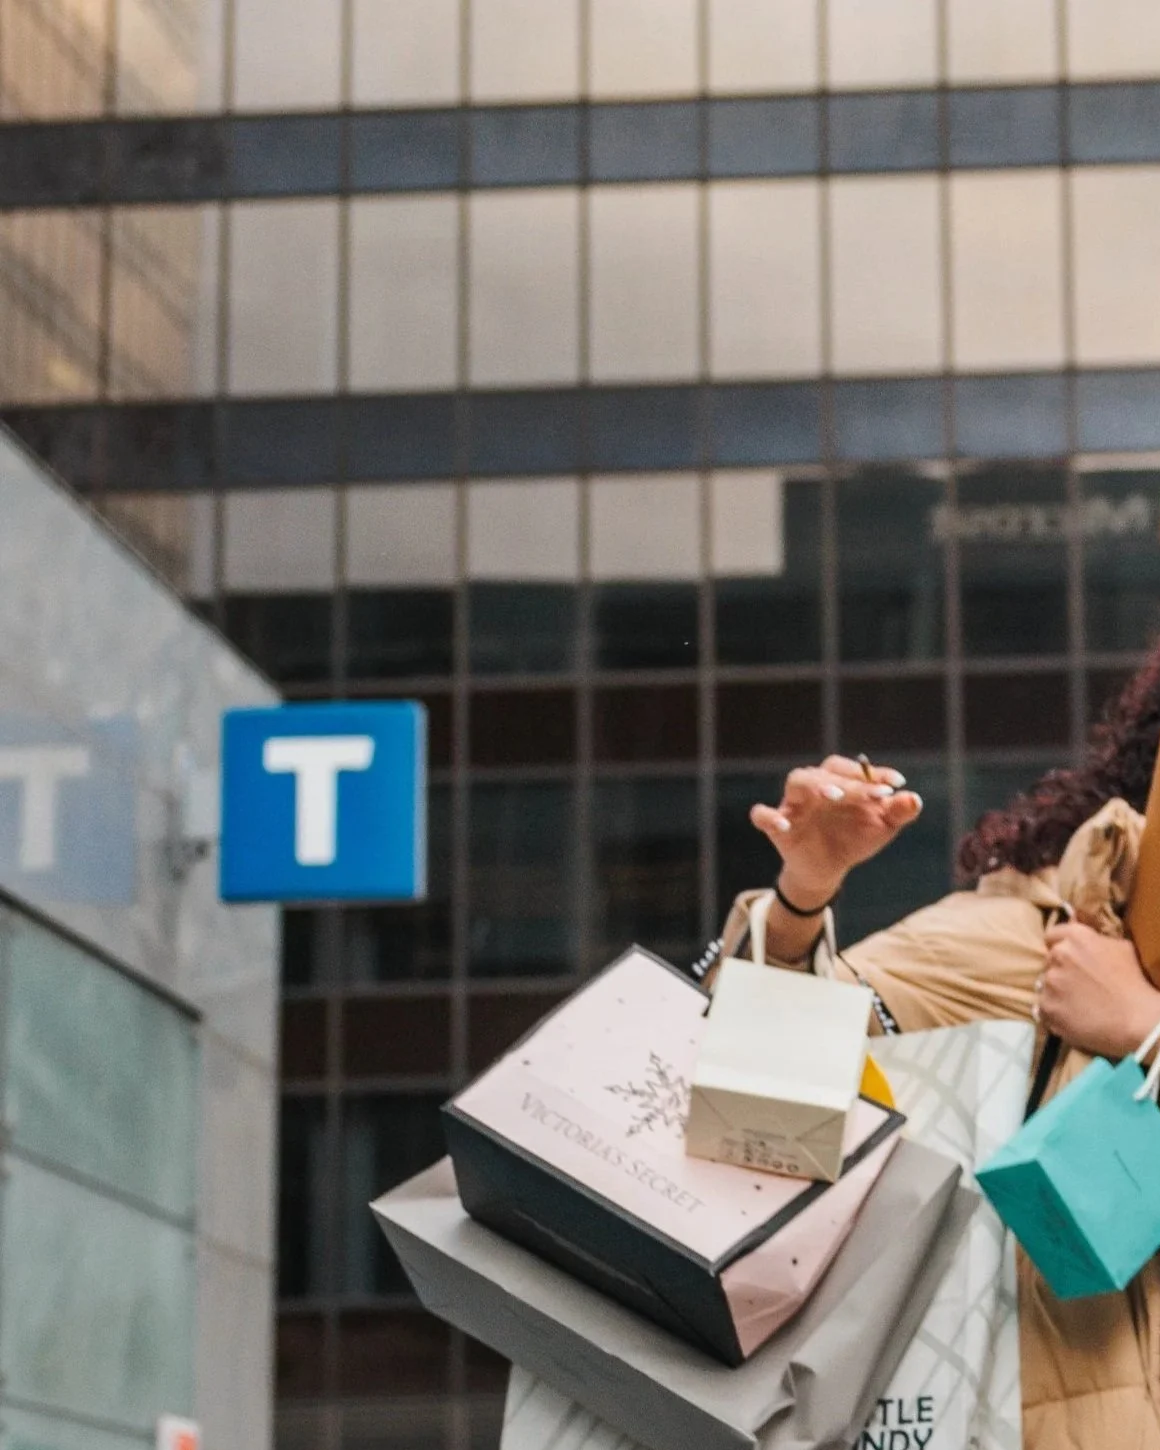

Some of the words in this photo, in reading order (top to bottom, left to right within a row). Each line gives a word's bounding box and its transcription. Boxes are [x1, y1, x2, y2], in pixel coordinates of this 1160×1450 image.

[262, 734, 375, 866] T
[624, 1157, 705, 1214] SECRET
[864, 1396, 934, 1427] TLE
